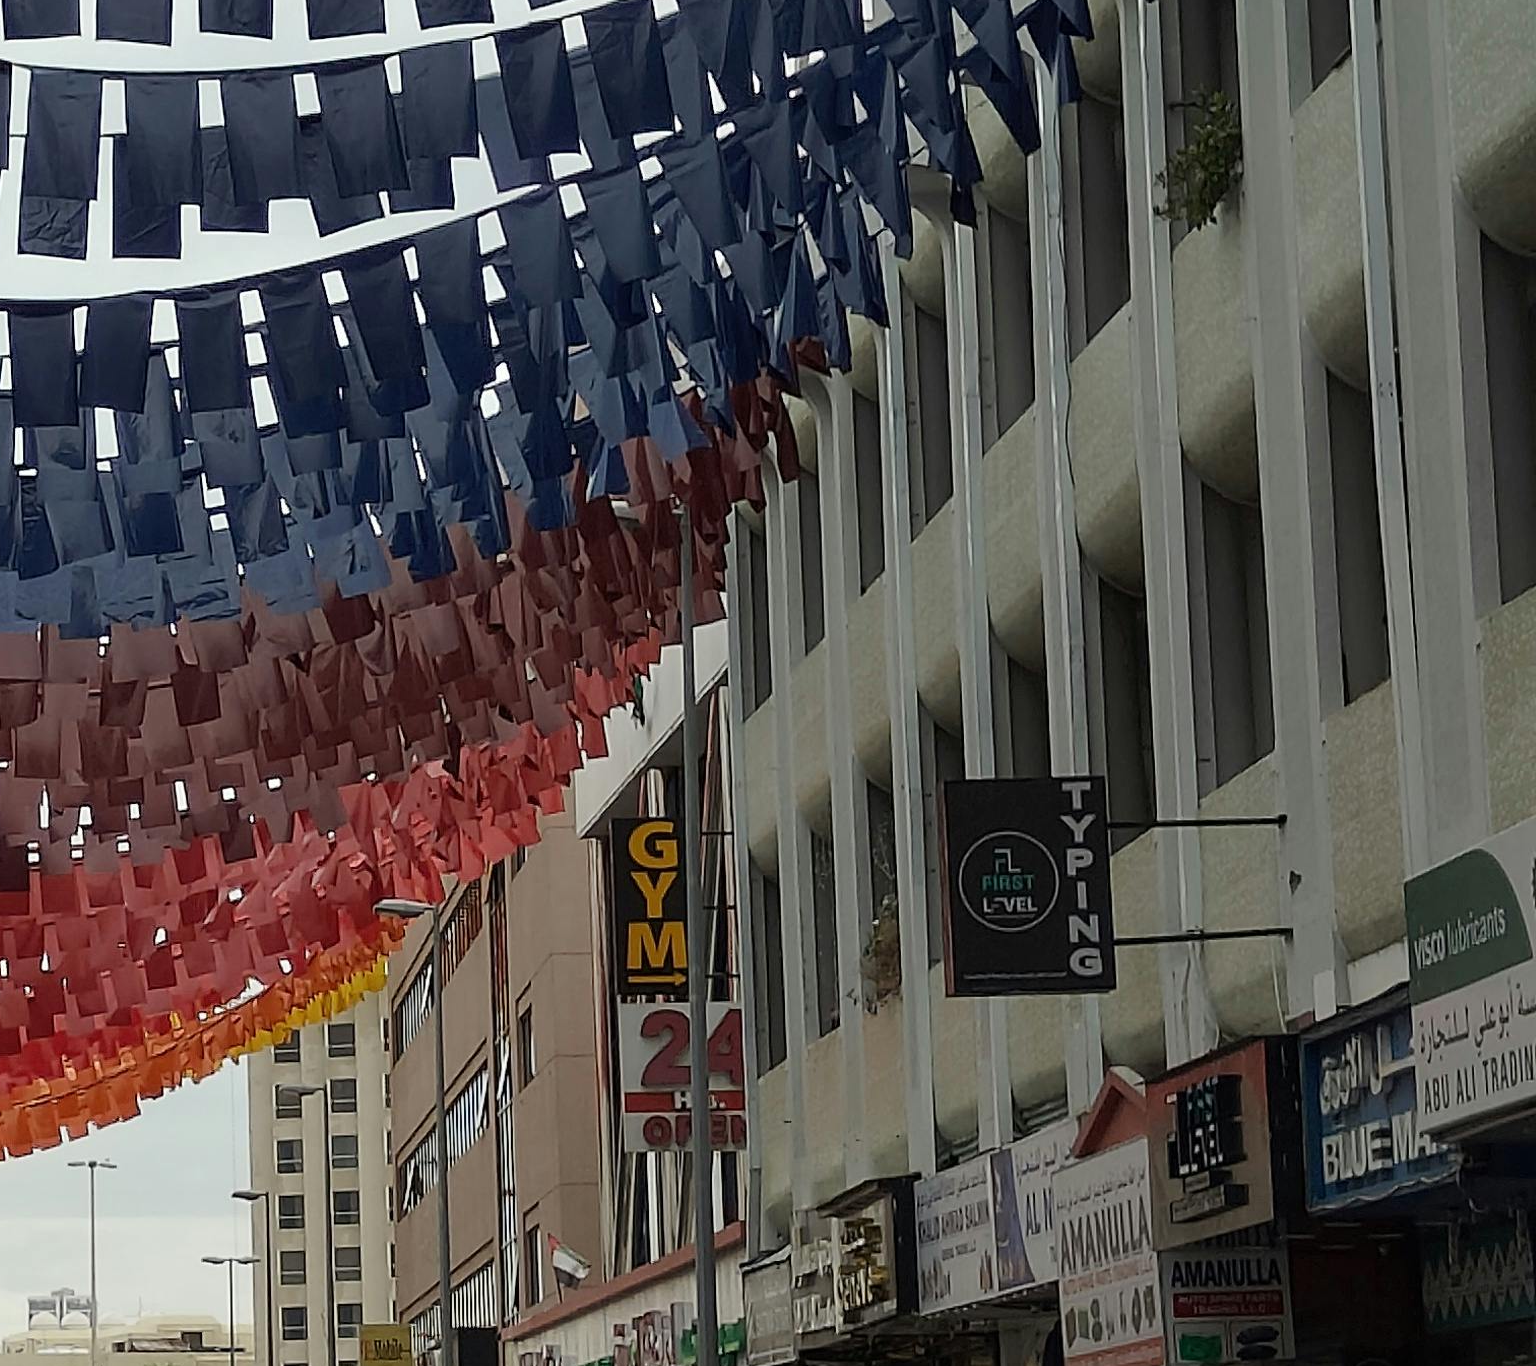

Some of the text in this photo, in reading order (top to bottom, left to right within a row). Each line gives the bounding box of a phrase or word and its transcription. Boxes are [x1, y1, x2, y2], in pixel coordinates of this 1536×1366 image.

[627, 820, 689, 970] GYM
[981, 874, 1034, 891] FIRST
[1059, 780, 1104, 977] TYPING
[1414, 906, 1506, 971] visco lubricants
[640, 1009, 743, 1087] 24
[1424, 1043, 1536, 1116] ABU ALI TRADIN
[1321, 1119, 1392, 1184] BLUE
[1061, 1193, 1152, 1276] AMANULLA
[1171, 1258, 1282, 1287] AMANULLA
